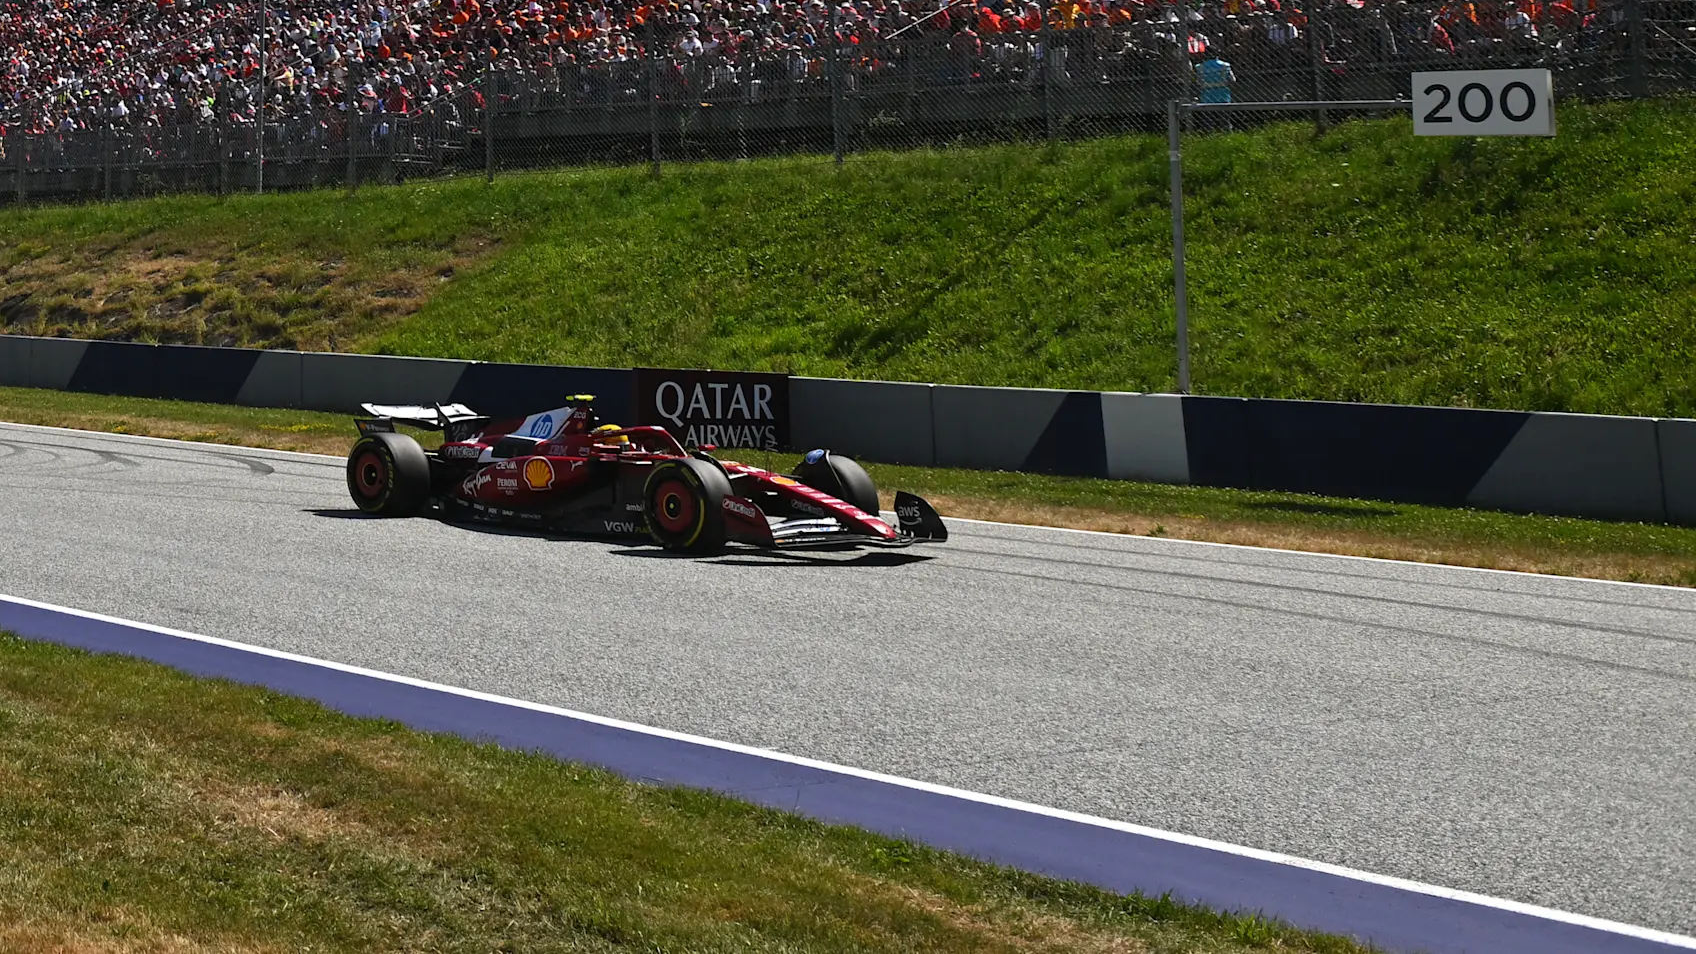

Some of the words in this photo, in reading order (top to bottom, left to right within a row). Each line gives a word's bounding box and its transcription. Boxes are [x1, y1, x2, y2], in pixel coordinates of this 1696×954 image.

[1423, 81, 1536, 123] 200
[655, 381, 775, 428] QATAR
[532, 415, 550, 438] hp
[685, 424, 776, 448] AIRWAYS
[496, 461, 517, 470] CEVA
[496, 478, 518, 486] PERONI
[898, 505, 920, 517] aws
[604, 520, 634, 532] VGW
